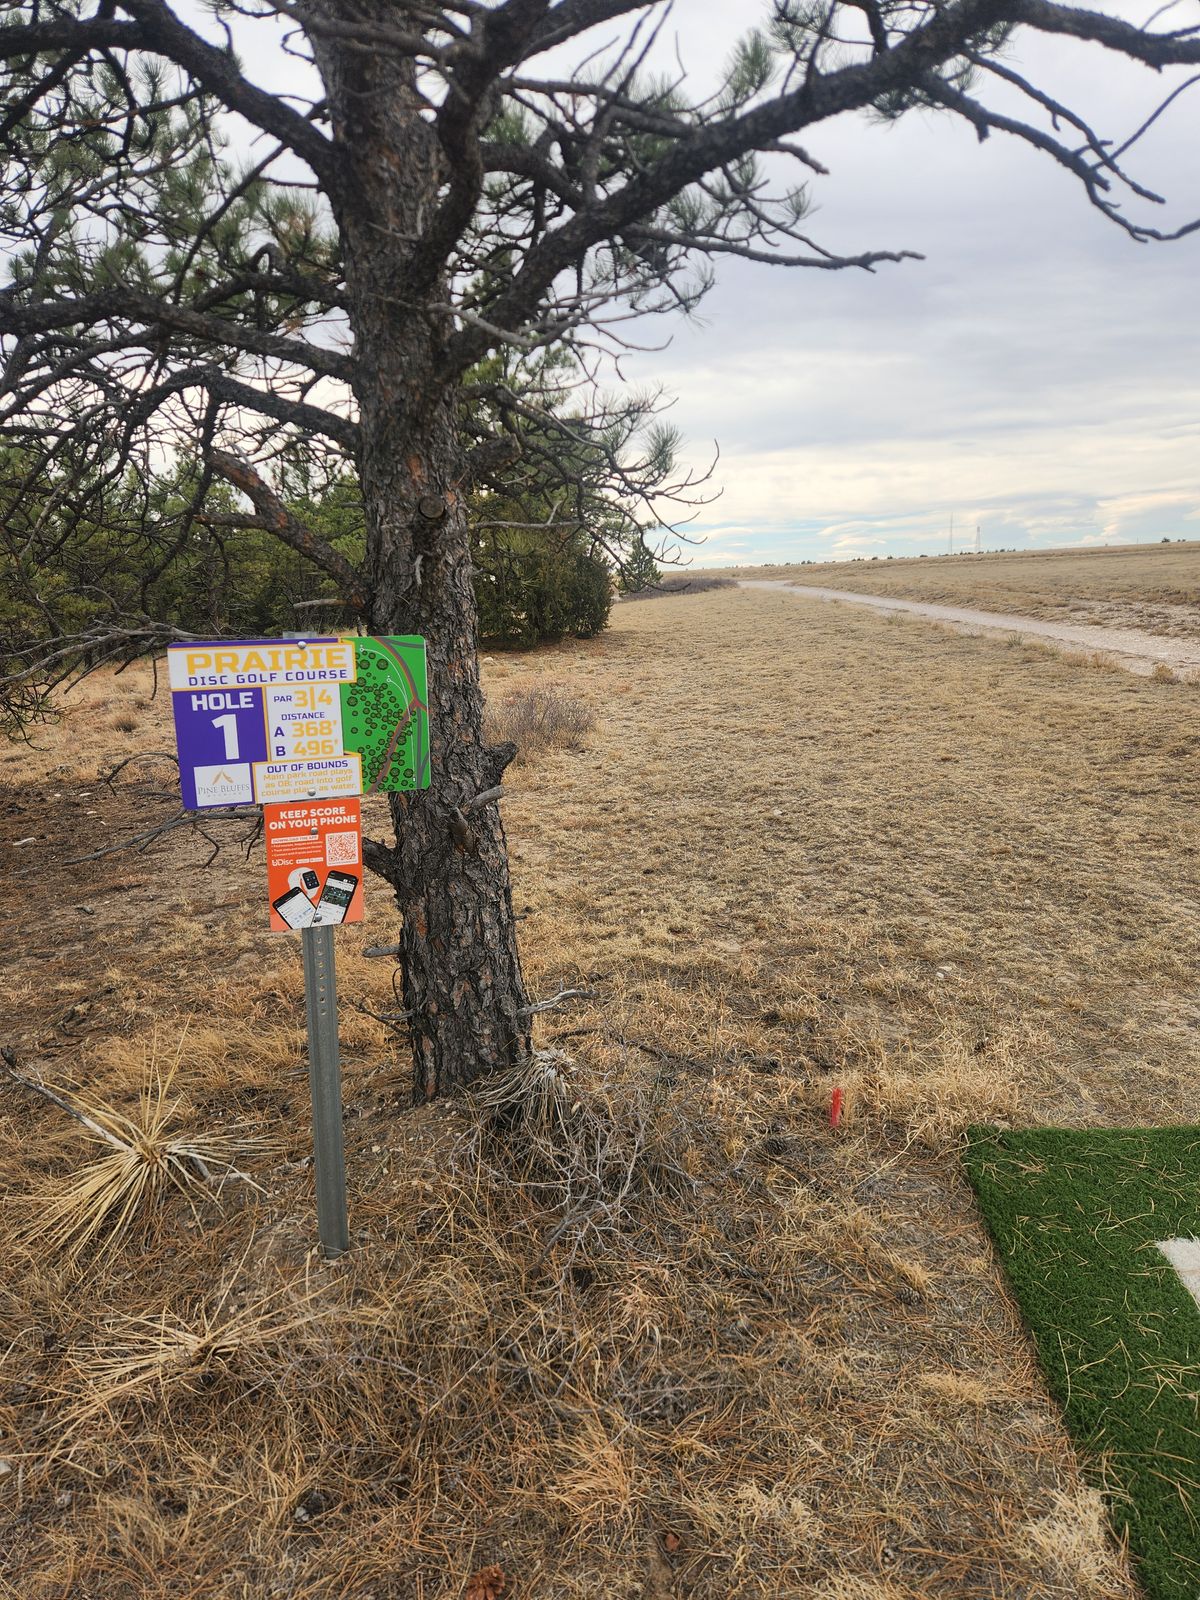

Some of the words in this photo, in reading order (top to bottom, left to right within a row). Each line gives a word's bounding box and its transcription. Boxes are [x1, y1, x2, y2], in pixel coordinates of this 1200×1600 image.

[187, 648, 347, 675] PRAIRIE
[189, 675, 228, 686] DISC
[236, 672, 277, 683] GOLF
[285, 669, 347, 681] COURSE
[191, 691, 254, 711] HOLE
[281, 711, 325, 720] DISTANCE
[274, 726, 285, 737] A
[291, 719, 337, 738] 368'
[211, 713, 240, 760] 1
[276, 745, 286, 757] B
[293, 739, 338, 755] 496'
[263, 772, 284, 780] Main
[287, 771, 307, 780] park
[308, 769, 328, 777] road
[330, 767, 353, 776] plays
[267, 764, 288, 773] OUT
[291, 763, 304, 772] OF
[307, 760, 348, 770] BOUNDS
[294, 777, 314, 786] road
[317, 776, 334, 784] into
[335, 774, 352, 783] golf
[197, 785, 219, 795] PINE
[221, 783, 250, 793] BLUFFS
[261, 788, 293, 797] course
[280, 809, 308, 820] KEEP
[310, 806, 346, 817] SCORE
[269, 821, 286, 830] ON
[288, 819, 318, 828] YOUR
[320, 815, 357, 826] PHONE
